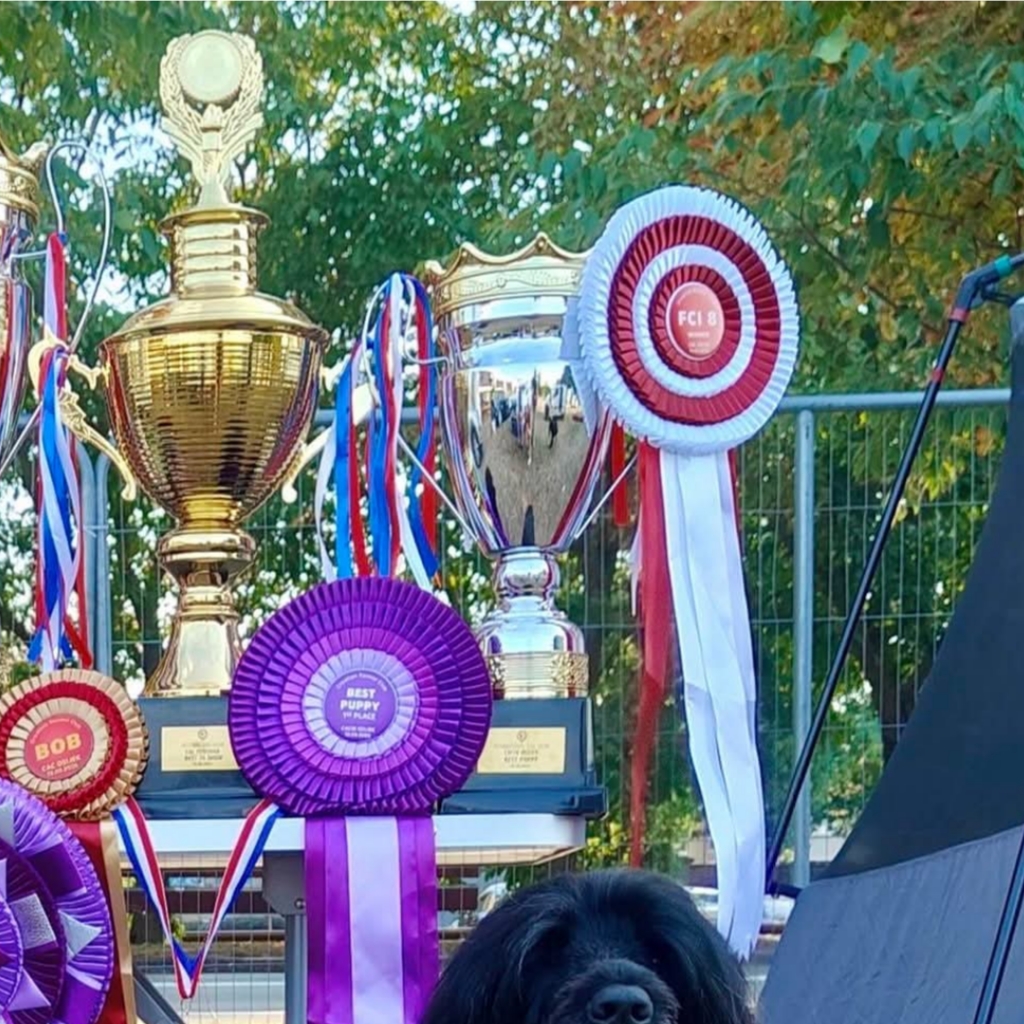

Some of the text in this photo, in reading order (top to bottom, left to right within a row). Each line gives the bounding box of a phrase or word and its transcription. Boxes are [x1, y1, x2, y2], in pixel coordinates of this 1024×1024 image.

[678, 310, 718, 327] FCI 8
[347, 687, 376, 699] BEST
[340, 699, 381, 711] PUPPY
[353, 711, 376, 720] PLACE
[34, 733, 82, 762] BOB
